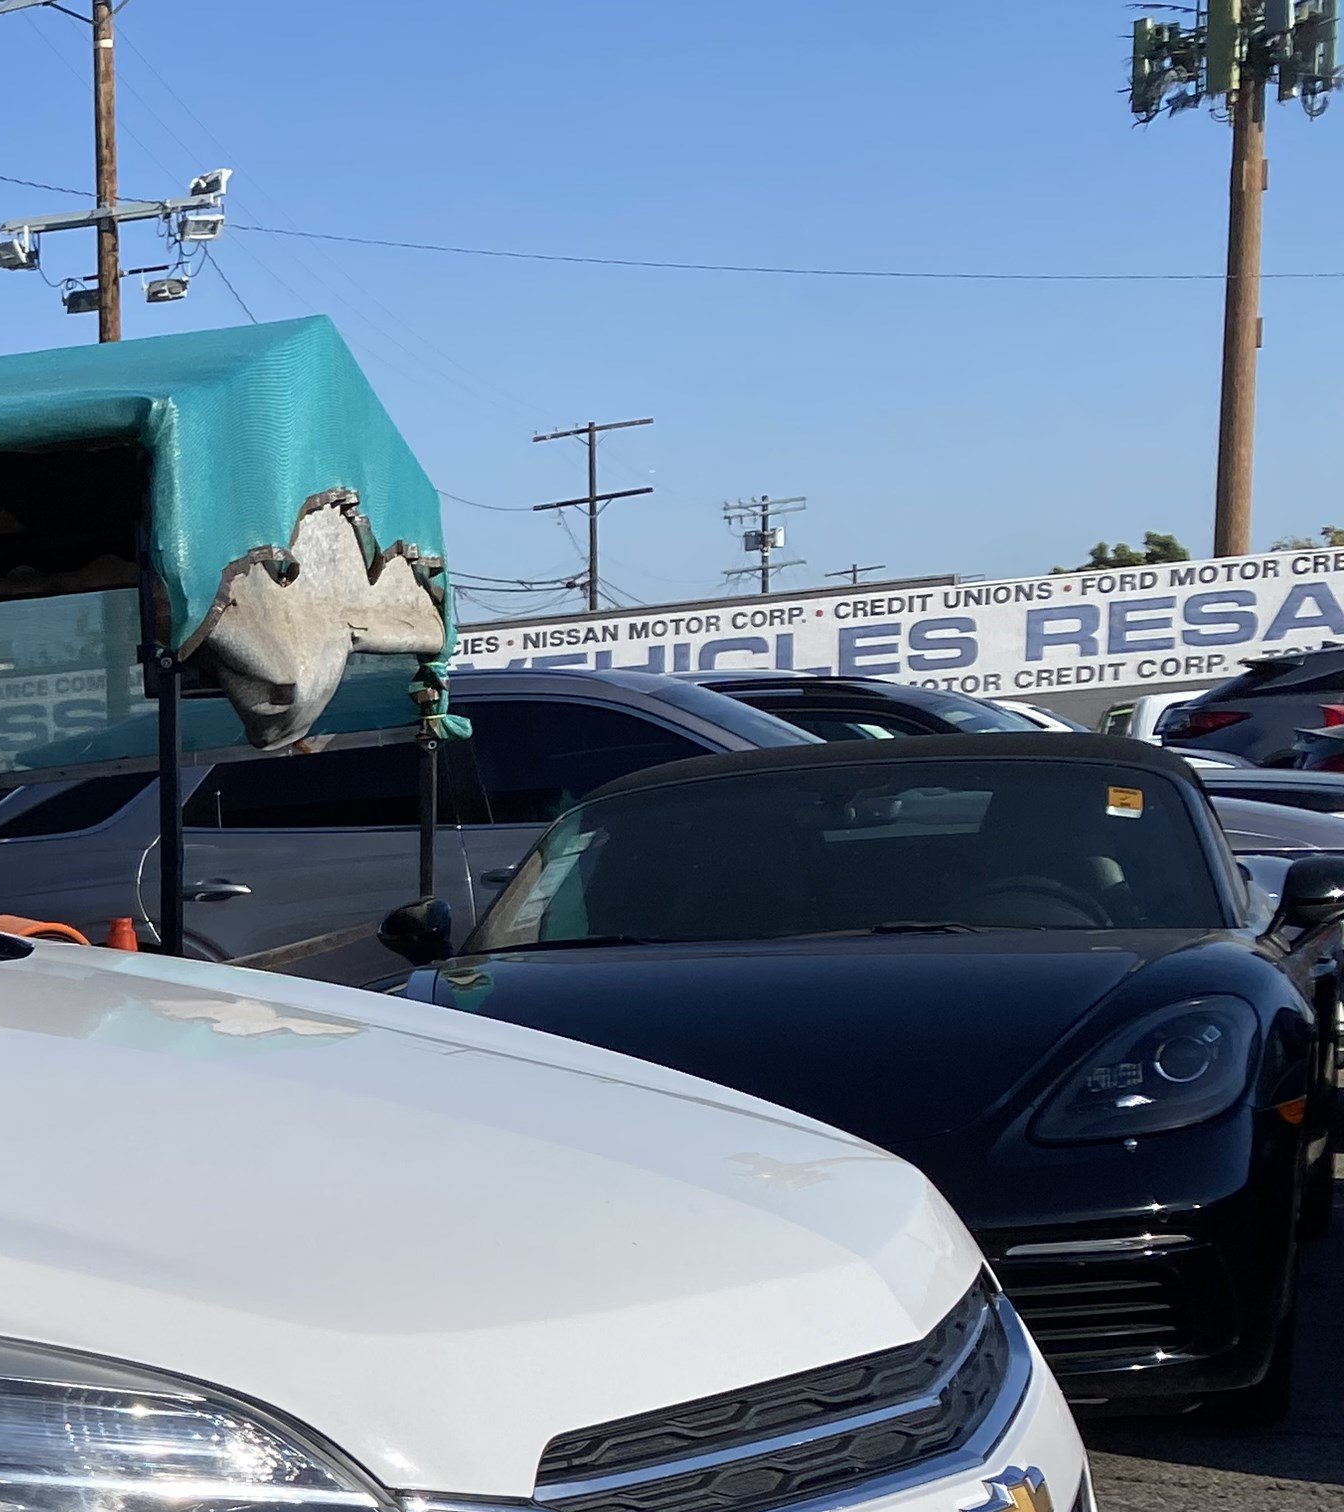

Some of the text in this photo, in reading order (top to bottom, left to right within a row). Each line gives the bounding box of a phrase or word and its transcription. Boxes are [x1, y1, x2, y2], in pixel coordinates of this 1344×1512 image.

[523, 624, 619, 649] NISSAN
[628, 614, 721, 640] MOTOR
[731, 606, 808, 631] CORP.
[834, 593, 933, 619] CREDIT
[943, 582, 1054, 609] UNIONS
[1081, 571, 1159, 596] FORD
[1169, 558, 1280, 587] MOTOR
[454, 616, 978, 678] HICLES
[1014, 662, 1127, 689] CREDIT
[1137, 654, 1229, 679] CORP.
